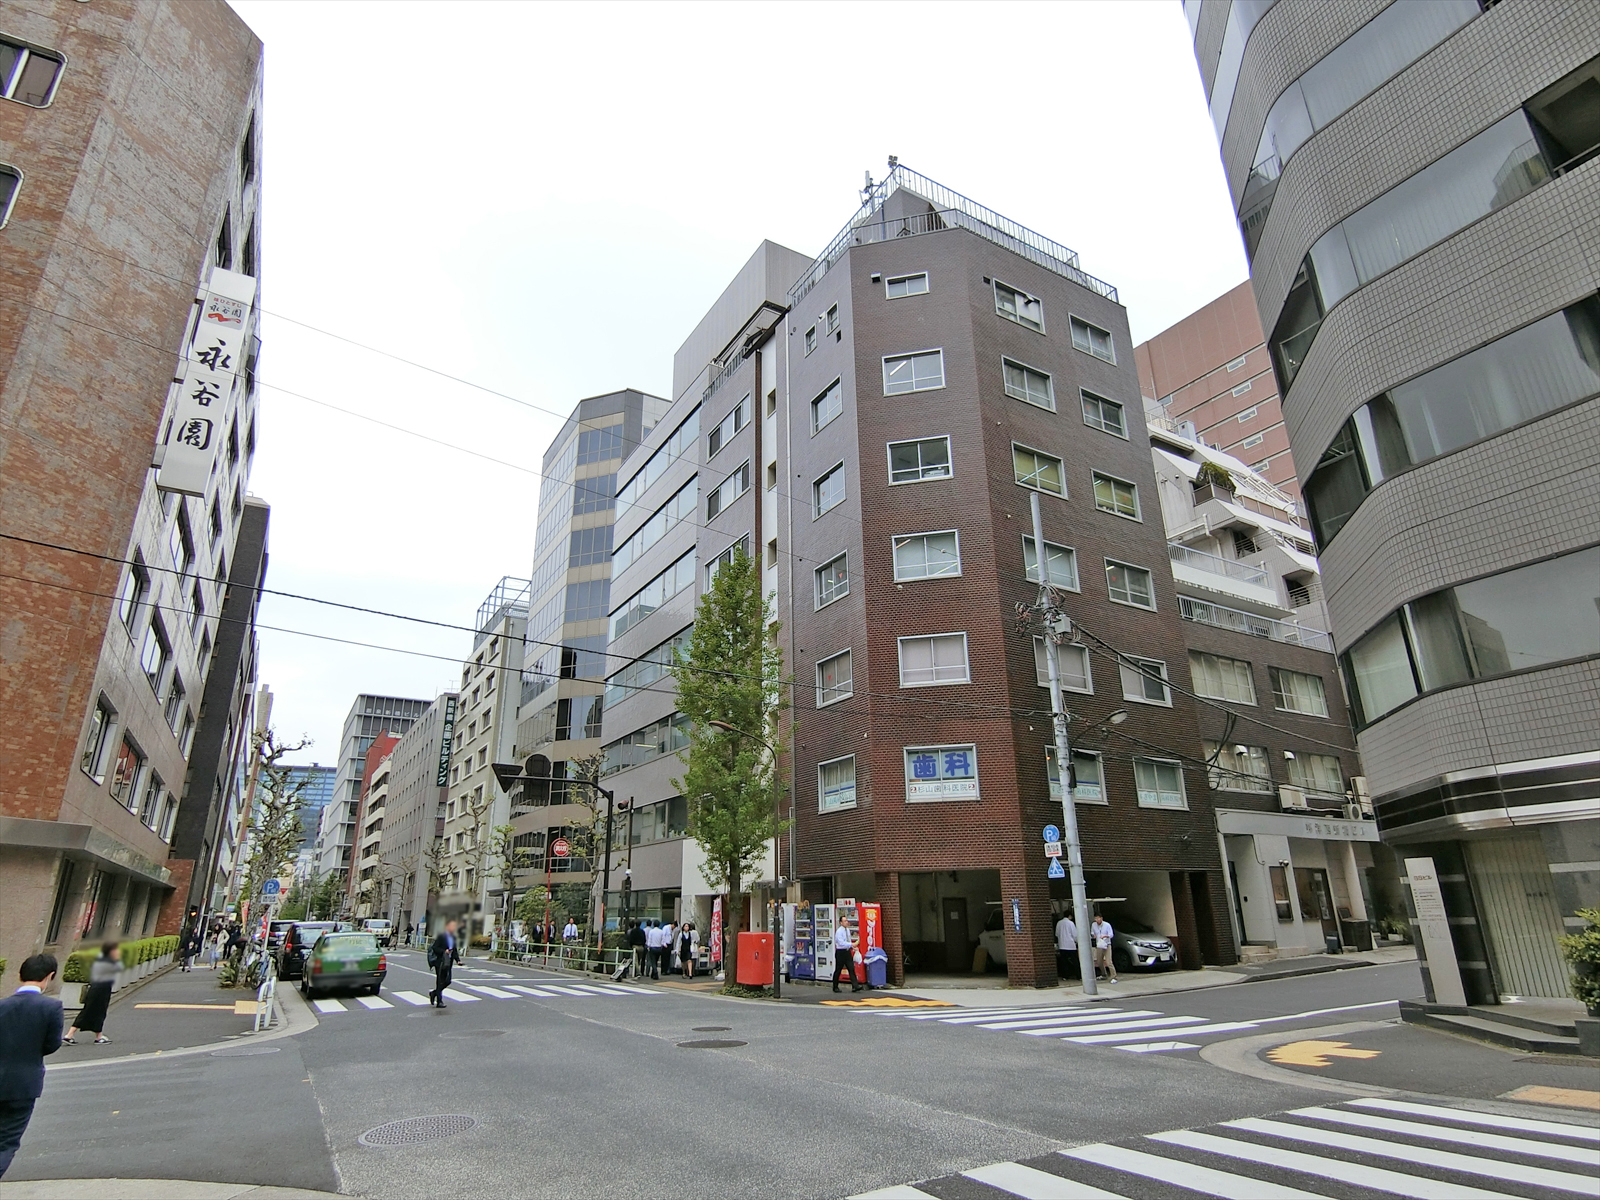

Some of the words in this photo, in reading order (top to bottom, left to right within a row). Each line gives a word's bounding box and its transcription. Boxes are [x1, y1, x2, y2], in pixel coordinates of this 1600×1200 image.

[209, 302, 242, 318] 永谷園
[177, 337, 232, 450] 永谷園
[912, 751, 971, 778] 歯科
